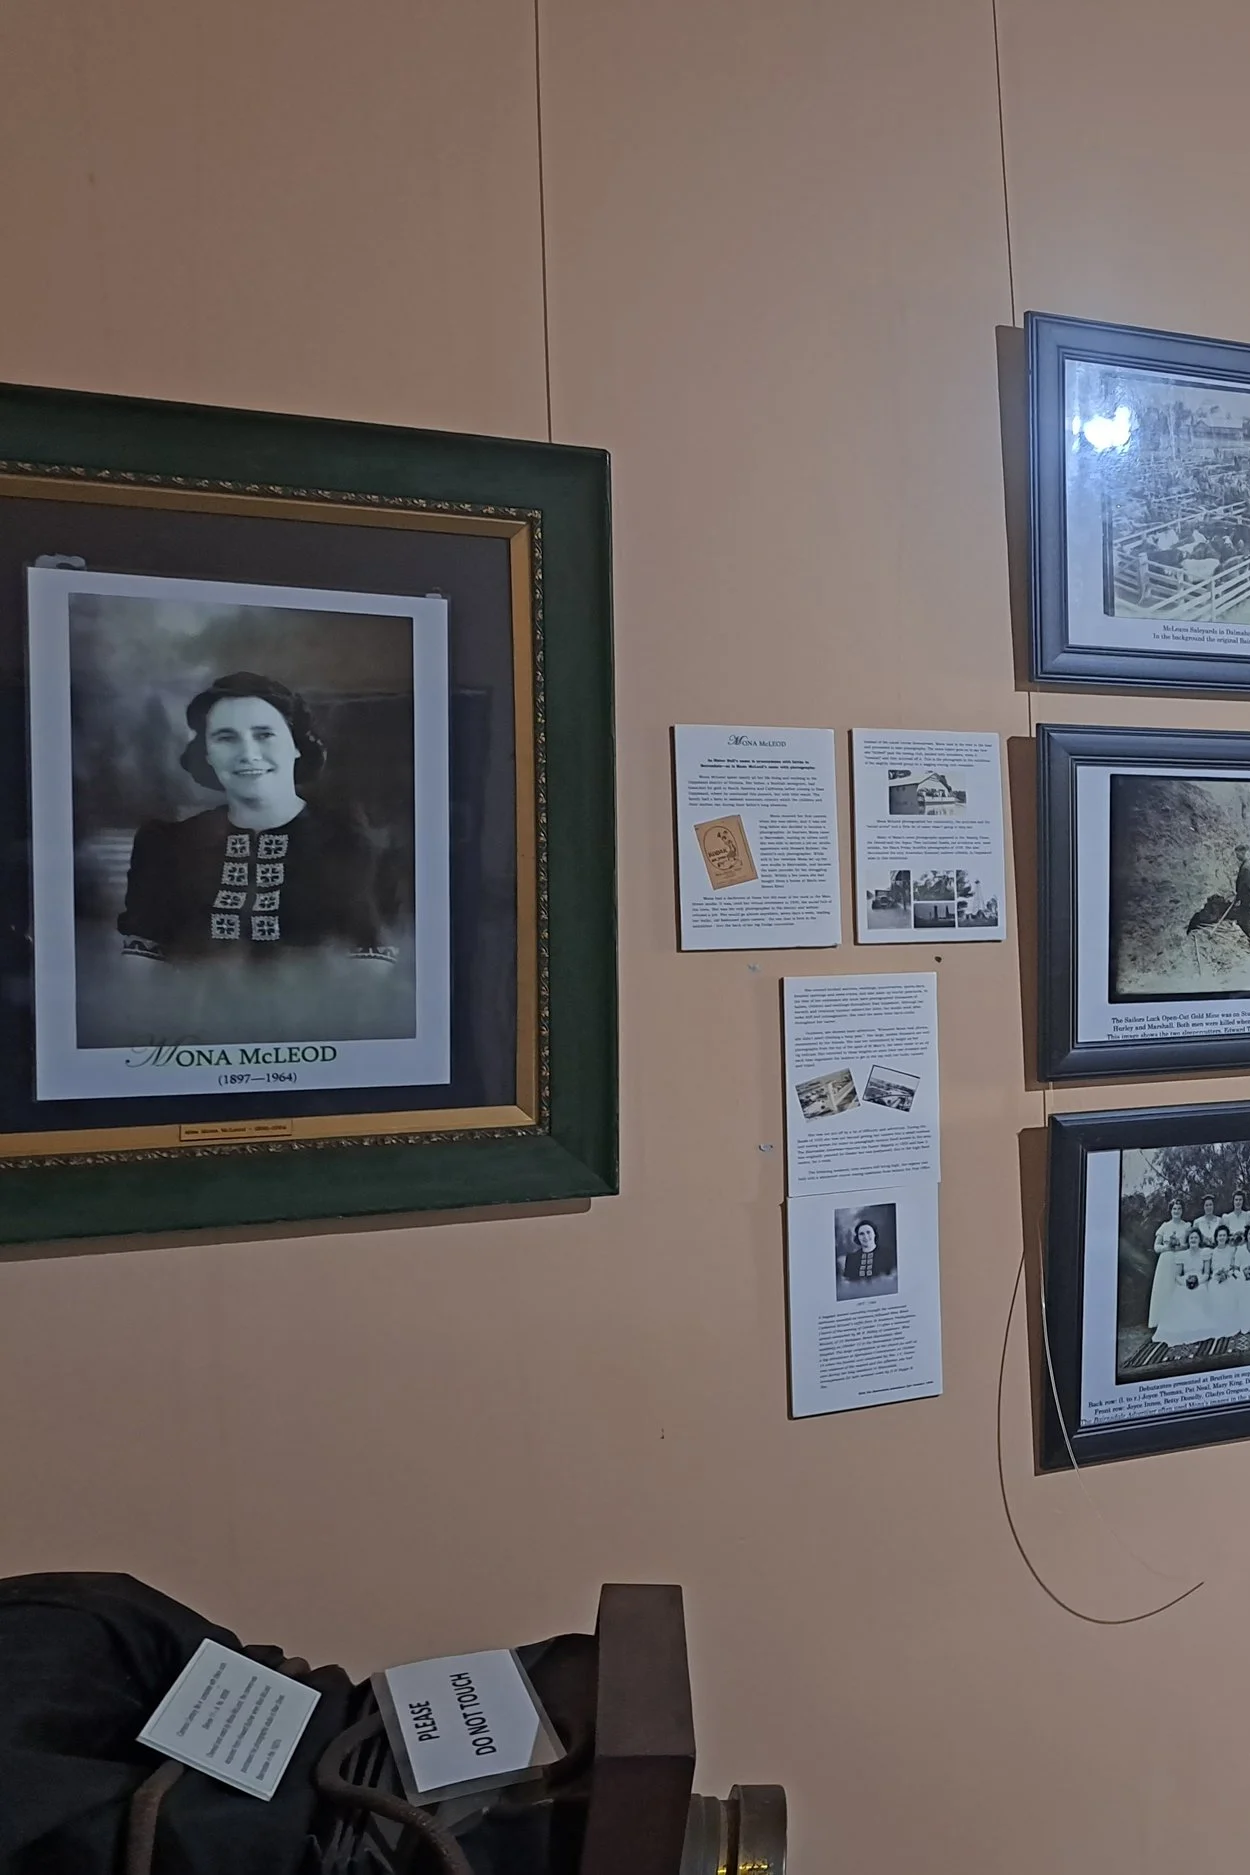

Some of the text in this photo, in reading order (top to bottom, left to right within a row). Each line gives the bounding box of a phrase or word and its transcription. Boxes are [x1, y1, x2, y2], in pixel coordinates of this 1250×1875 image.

[1172, 633, 1205, 642] background
[727, 735, 757, 747] MONA
[125, 1036, 337, 1067] MONA McLEOD
[1088, 1400, 1102, 1408] Back
[1142, 1392, 1158, 1400] Joyce
[1094, 1407, 1110, 1415] Front
[1127, 1403, 1142, 1411] Joyce
[409, 1700, 440, 1741] PLEASE
[449, 1672, 497, 1756] DO NOT TOUCH
